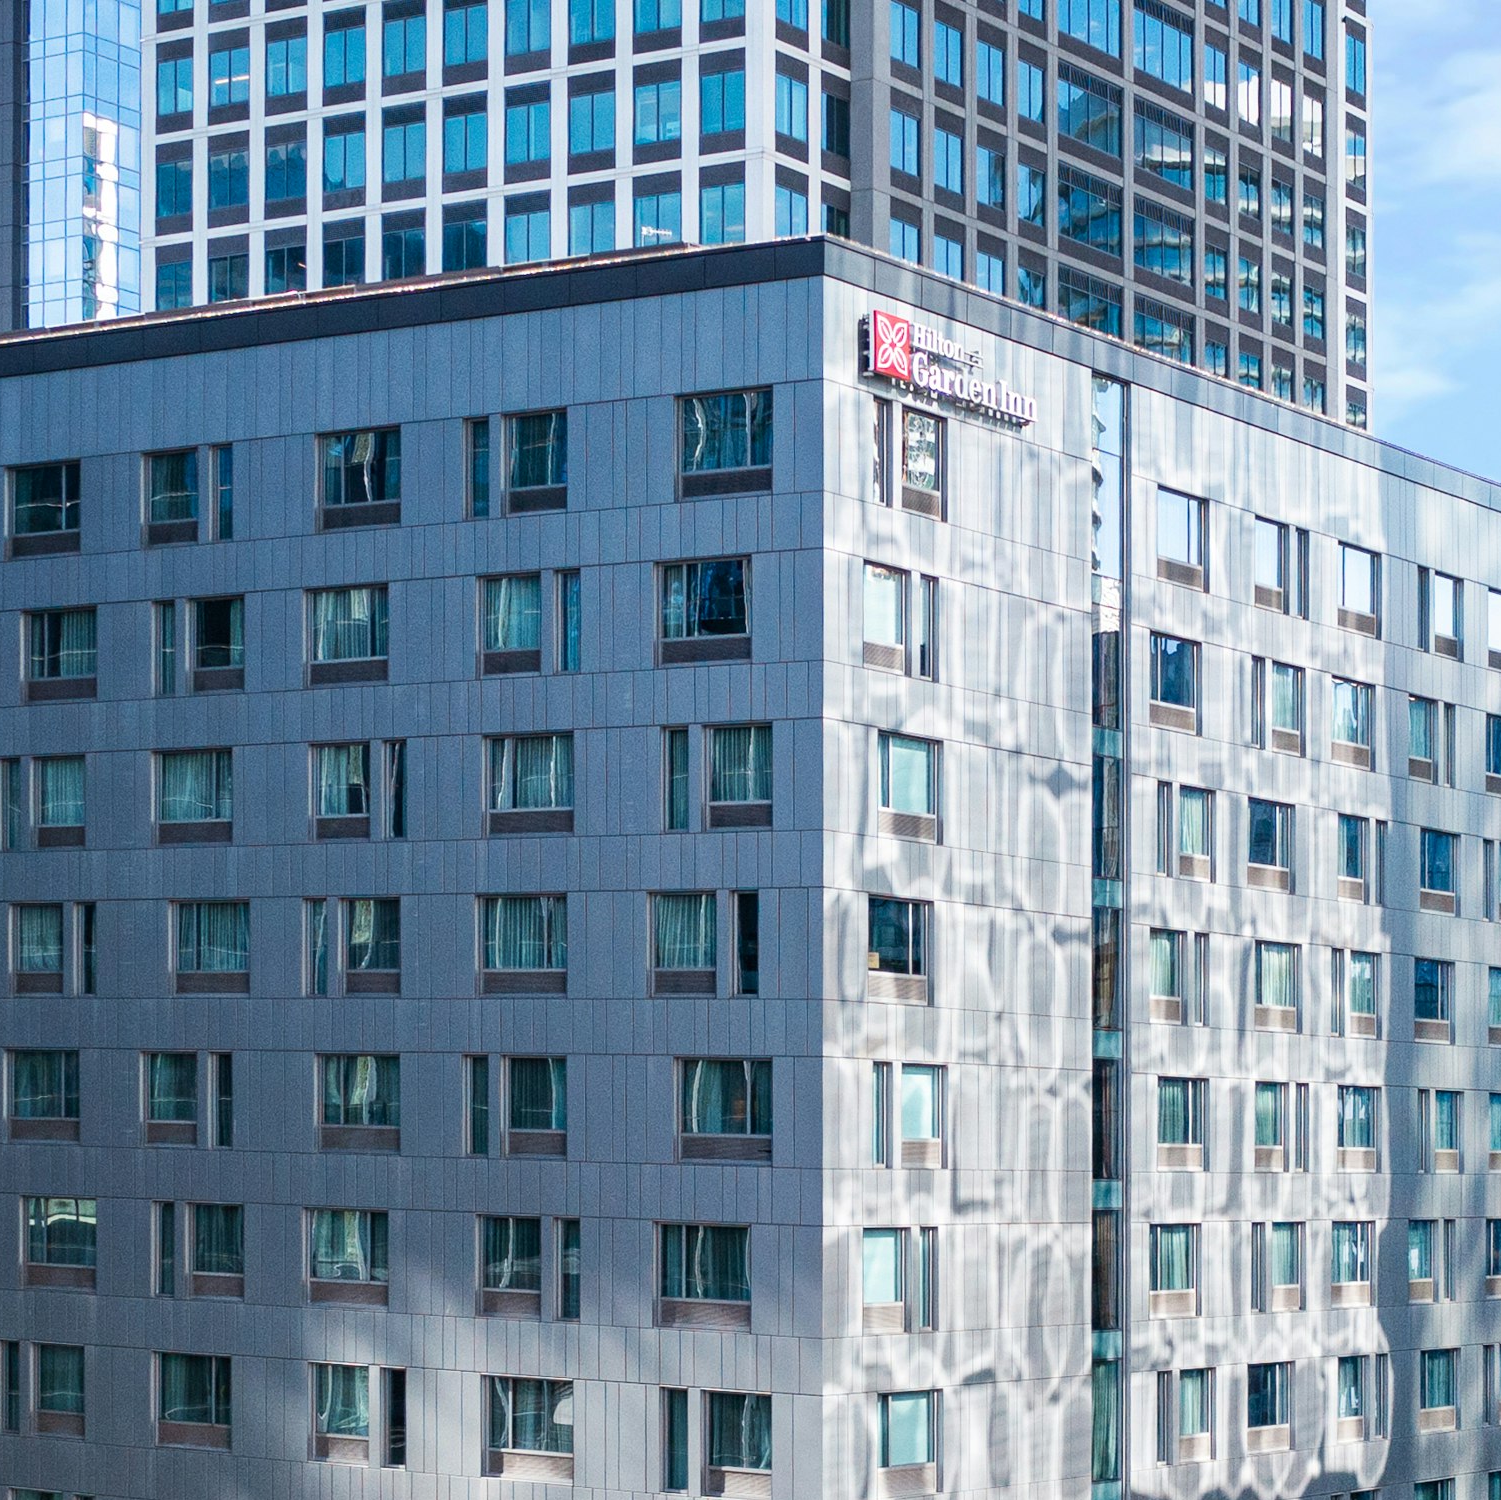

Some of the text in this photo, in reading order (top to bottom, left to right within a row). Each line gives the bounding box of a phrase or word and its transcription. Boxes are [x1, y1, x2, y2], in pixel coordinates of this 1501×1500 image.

[913, 324, 964, 359] Hilton
[913, 353, 1037, 421] Garden Inn
